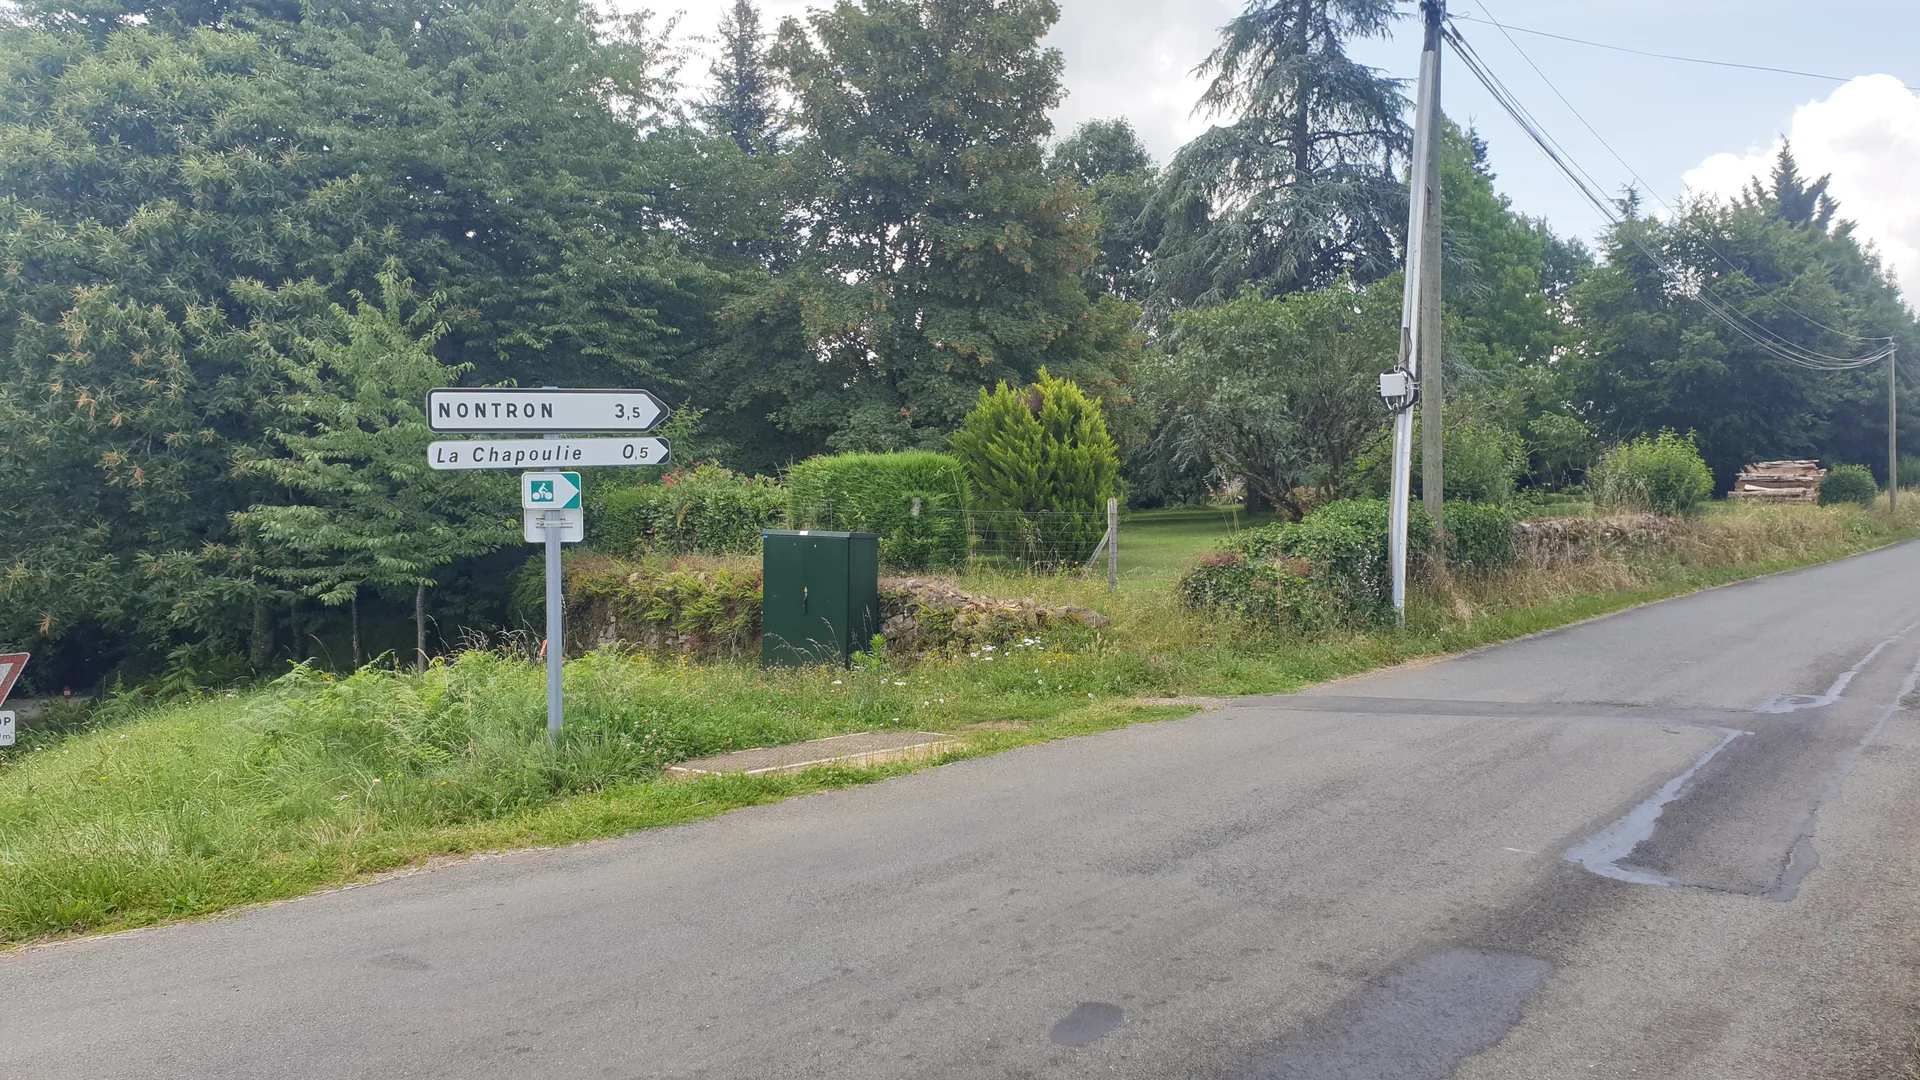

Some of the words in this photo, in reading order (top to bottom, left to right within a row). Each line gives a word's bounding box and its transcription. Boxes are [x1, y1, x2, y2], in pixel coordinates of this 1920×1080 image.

[439, 402, 553, 418] NONTRON
[614, 403, 641, 421] 3,5
[436, 448, 459, 463] La
[472, 445, 582, 465] Chapoulie
[622, 444, 649, 461] 0,5
